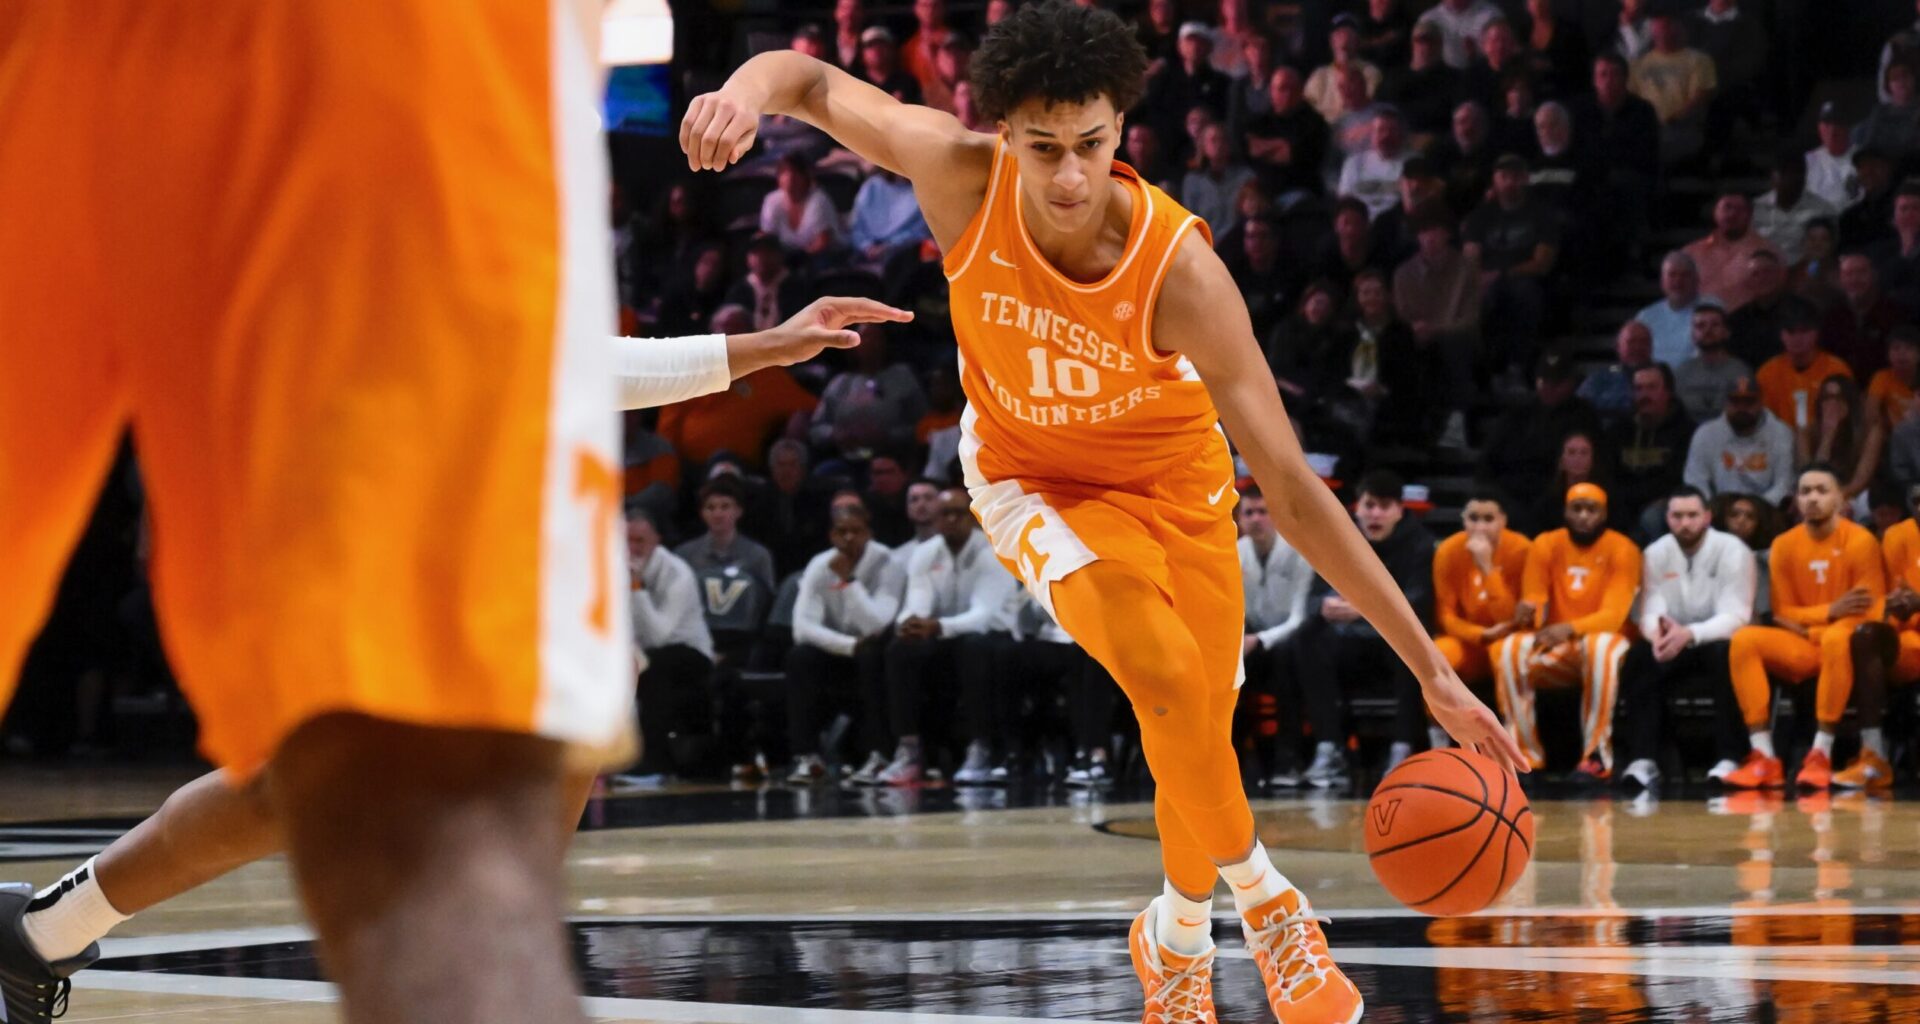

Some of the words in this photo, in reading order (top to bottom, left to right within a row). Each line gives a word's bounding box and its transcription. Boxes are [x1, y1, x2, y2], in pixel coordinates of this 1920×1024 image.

[981, 291, 1136, 372] TENNESSEE
[1027, 346, 1101, 398] 10
[1566, 566, 1590, 592] T
[1807, 559, 1830, 585] T
[705, 577, 749, 615] V
[1372, 798, 1402, 837] V
